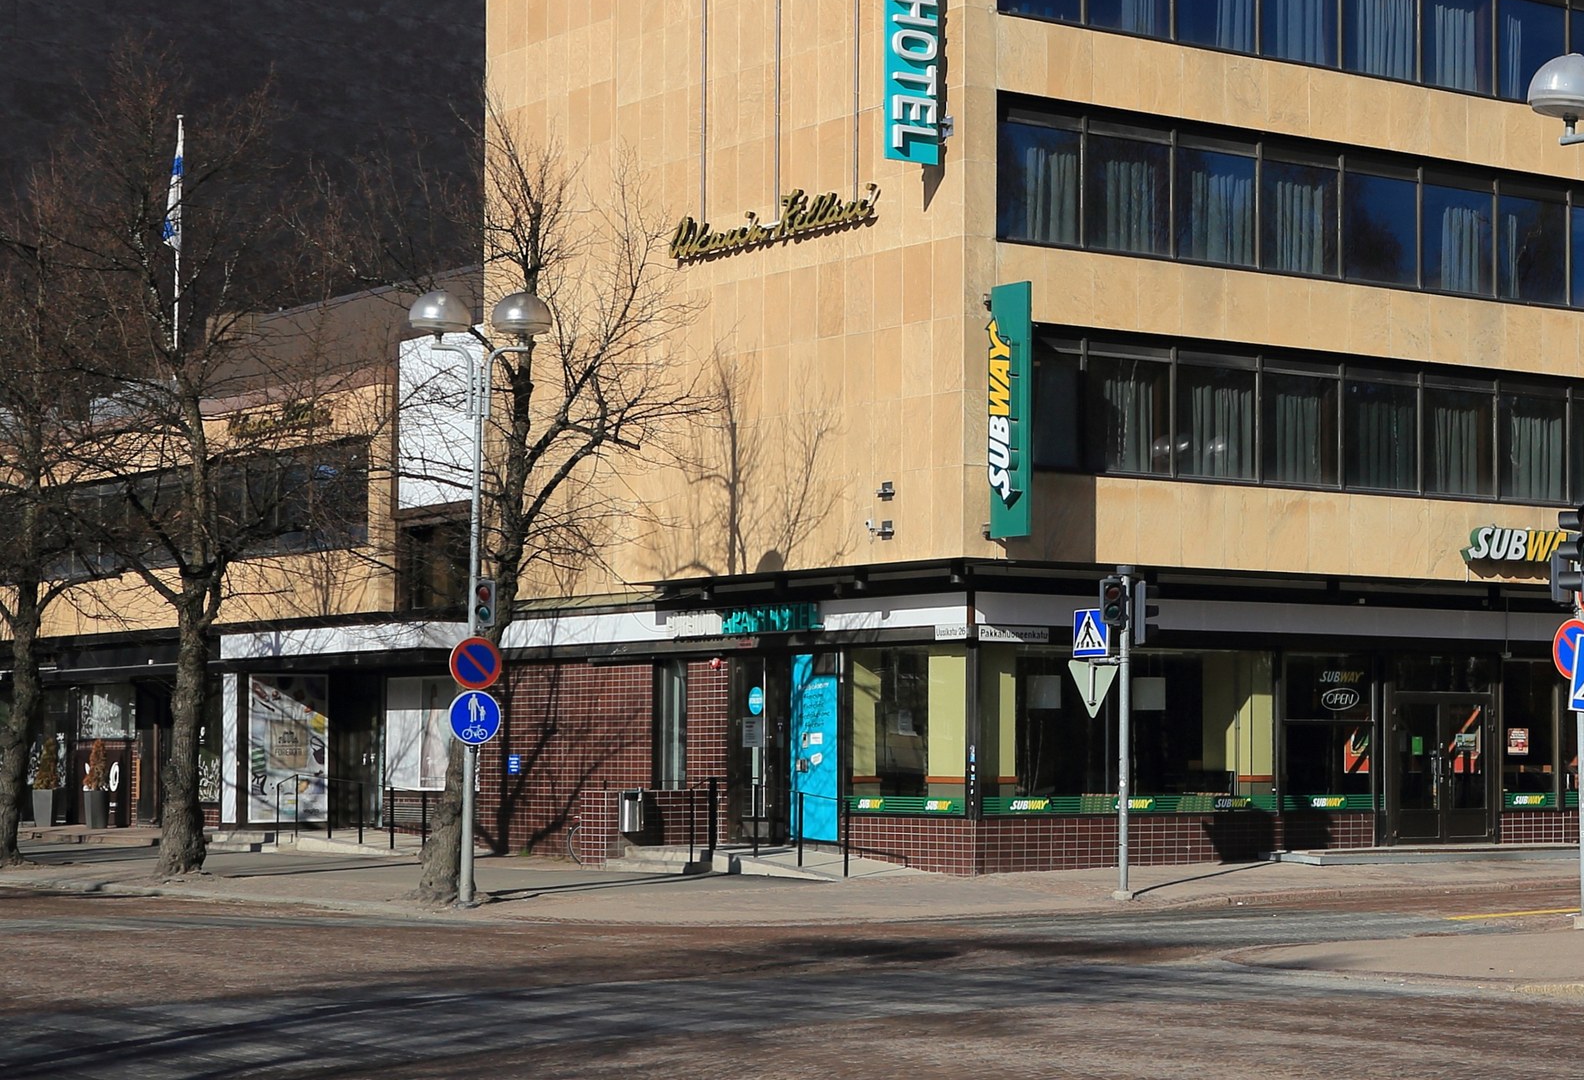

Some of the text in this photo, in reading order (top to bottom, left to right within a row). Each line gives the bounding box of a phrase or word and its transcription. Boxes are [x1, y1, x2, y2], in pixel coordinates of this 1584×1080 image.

[986, 318, 1011, 501] SUBWAY
[958, 627, 966, 636] 26
[980, 628, 1049, 640] Pakkahuoneenkatu
[1319, 670, 1364, 683] SUBWAY
[1326, 693, 1355, 705] OPEN
[1010, 799, 1049, 810] SUBWAY
[1215, 797, 1251, 808] SUBWAY
[1311, 797, 1344, 807] SUBWAY
[1513, 795, 1544, 805] SUBWAY
